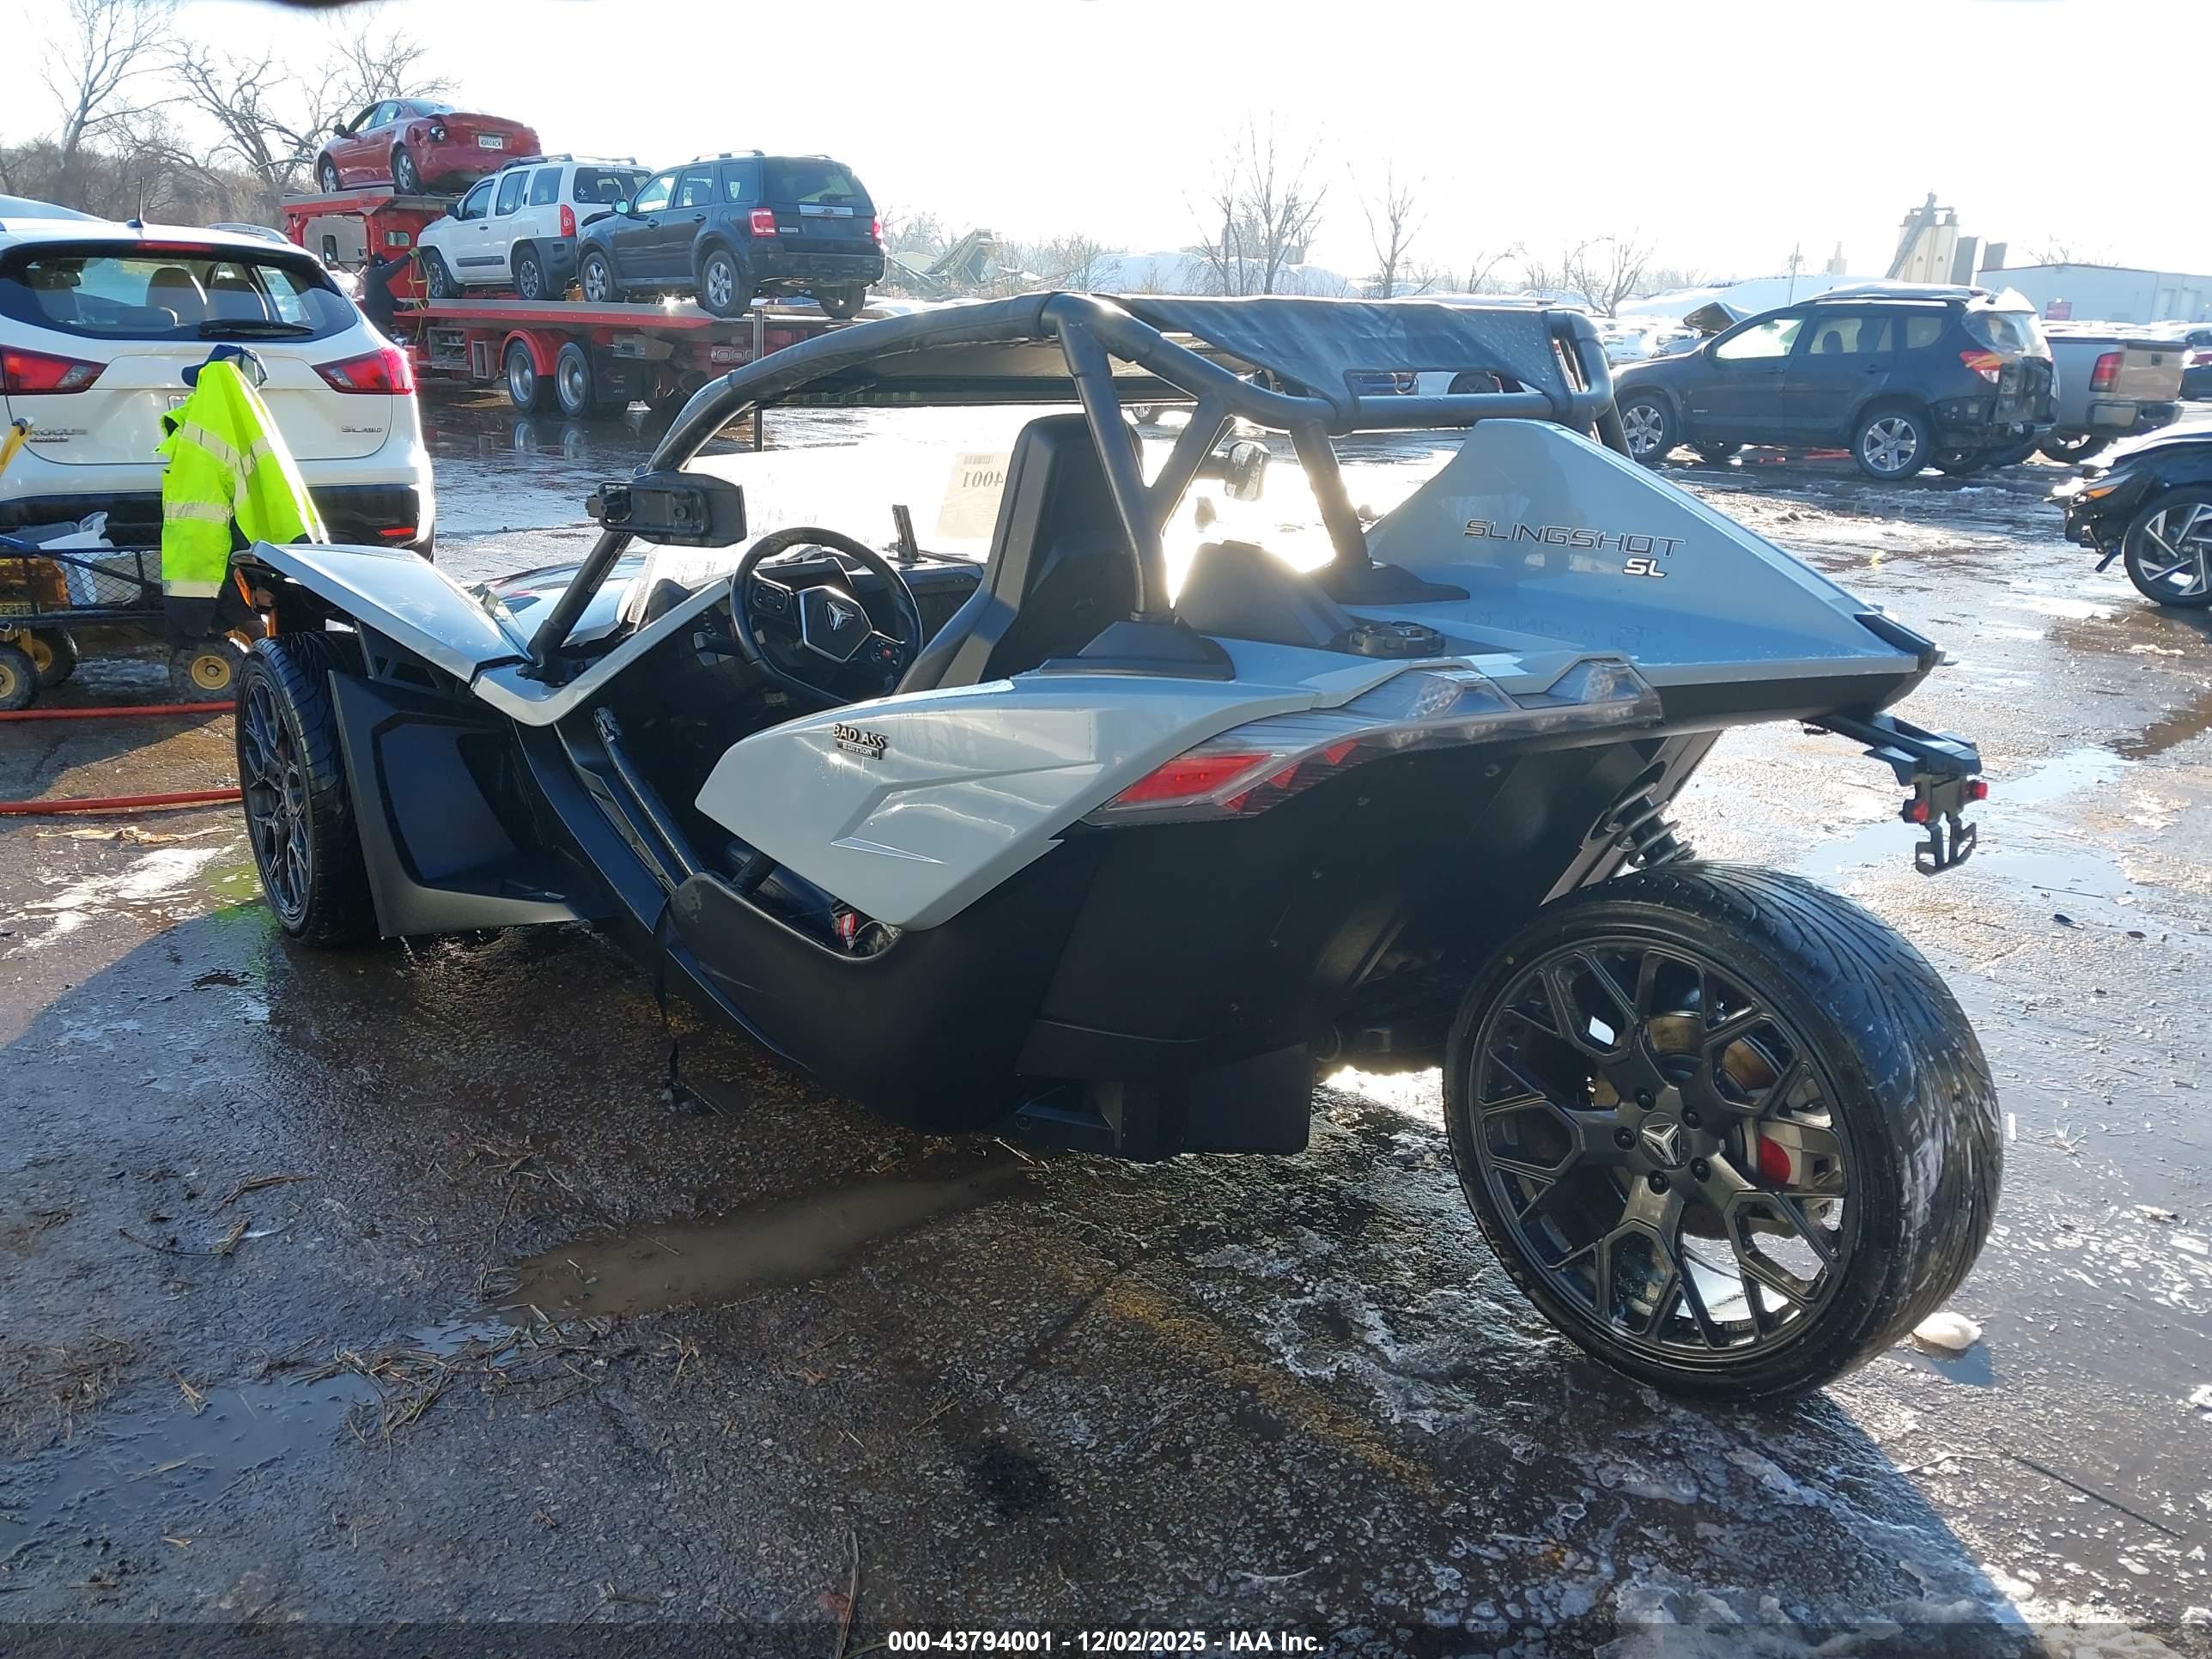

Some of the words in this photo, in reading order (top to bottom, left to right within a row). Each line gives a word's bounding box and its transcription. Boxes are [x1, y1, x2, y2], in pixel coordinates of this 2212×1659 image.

[1463, 519, 1686, 557] SLINGSHOT
[1622, 557, 1668, 578] SL
[833, 724, 859, 742] BAD
[861, 732, 887, 750] ASS
[842, 742, 873, 757] EDITION
